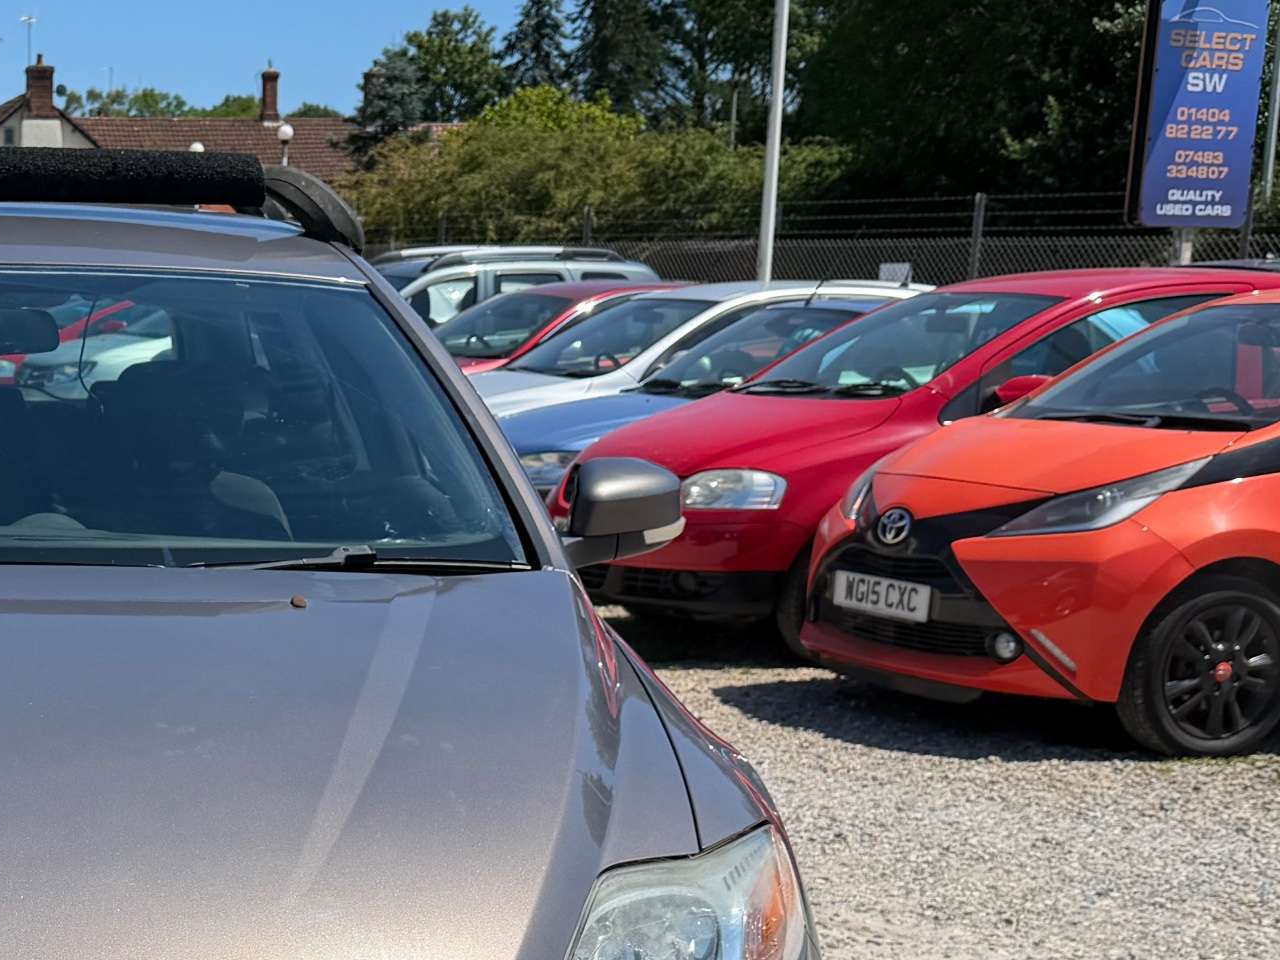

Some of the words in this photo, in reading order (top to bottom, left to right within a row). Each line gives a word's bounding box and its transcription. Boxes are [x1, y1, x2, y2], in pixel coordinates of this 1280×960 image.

[1170, 29, 1256, 51] SELECT
[1181, 50, 1245, 71] CARS
[1186, 71, 1228, 93] SW
[1177, 106, 1231, 122] 01404
[1175, 150, 1224, 164] 07483
[1167, 165, 1229, 179] 334807
[1168, 188, 1223, 202] QUALITY
[1156, 203, 1193, 215] USED
[1195, 204, 1232, 216] CARS
[885, 583, 918, 612] CXC
